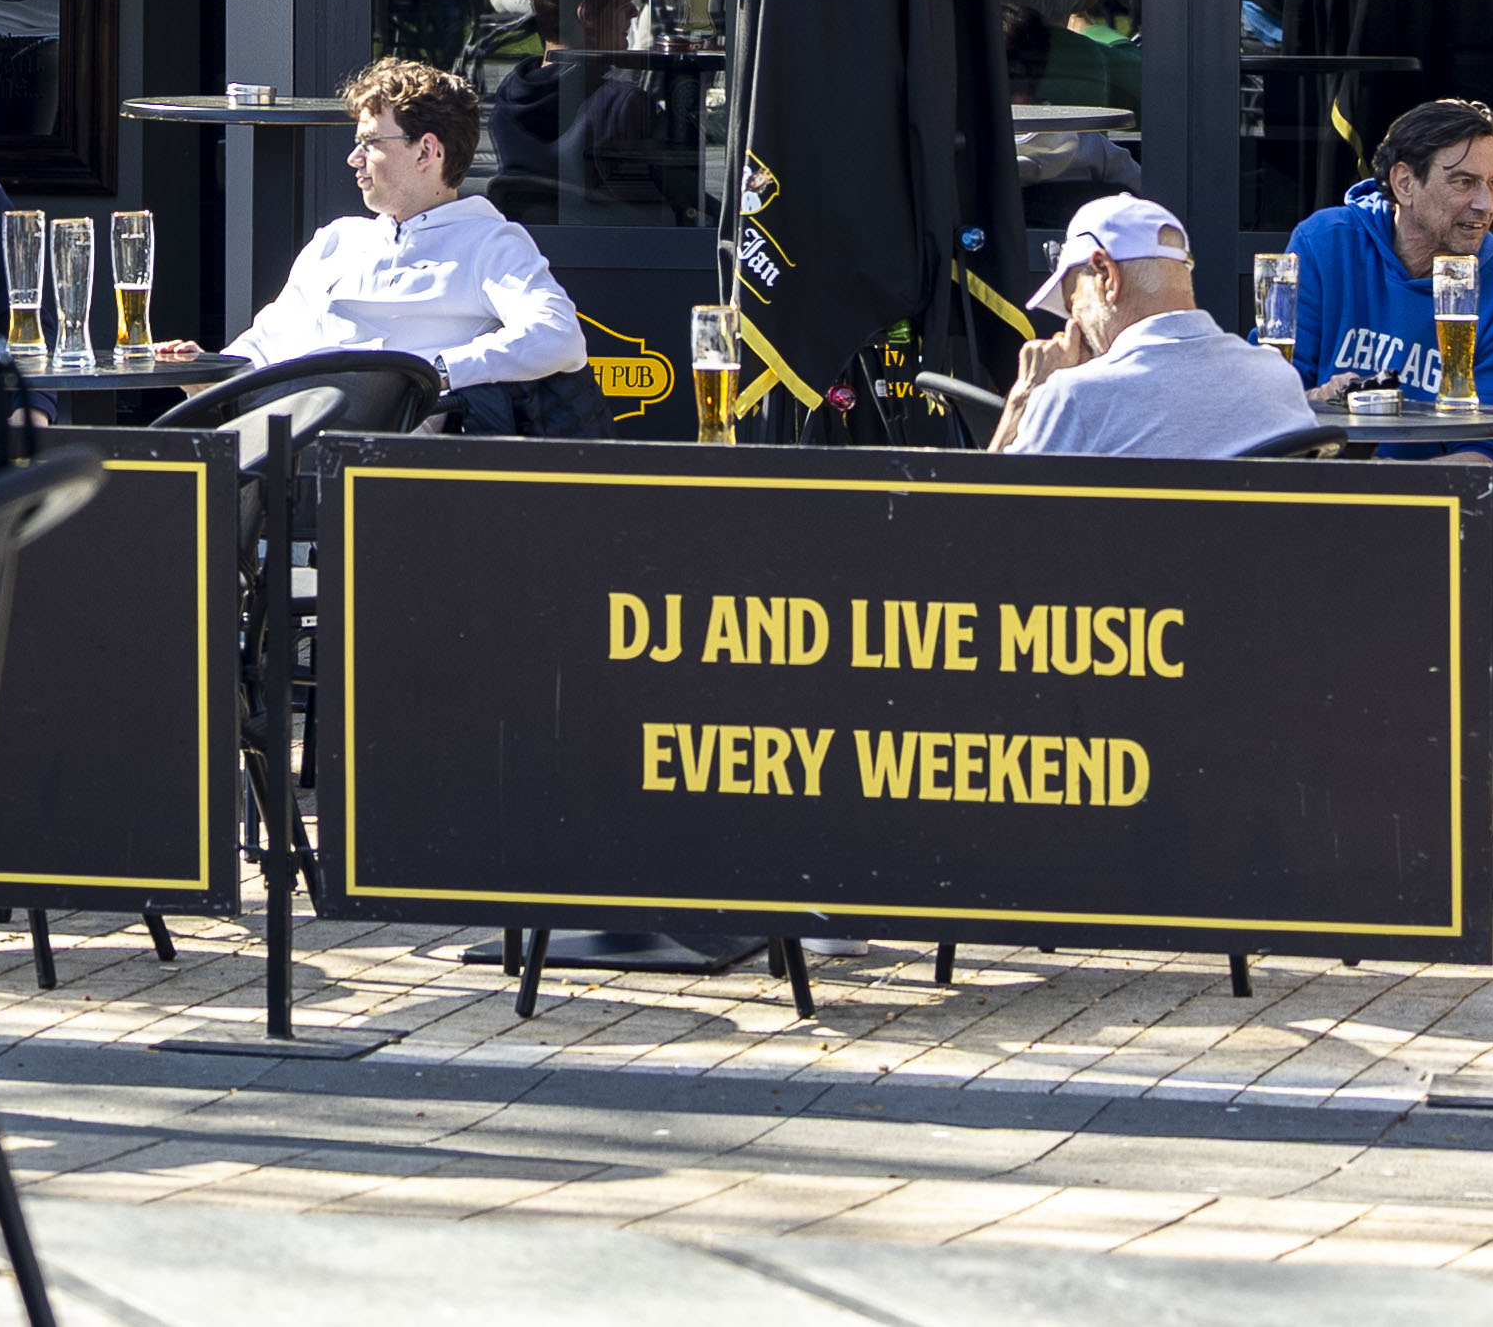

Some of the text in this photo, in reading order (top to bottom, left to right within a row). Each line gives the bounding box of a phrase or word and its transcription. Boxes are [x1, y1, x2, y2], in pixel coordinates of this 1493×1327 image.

[736, 228, 783, 289] Jan
[611, 365, 654, 387] PUB
[1333, 326, 1444, 395] CHICAG
[607, 591, 1185, 679] DJ AND LIVE MUSIC
[641, 721, 1151, 808] EVERY WEEKEND
